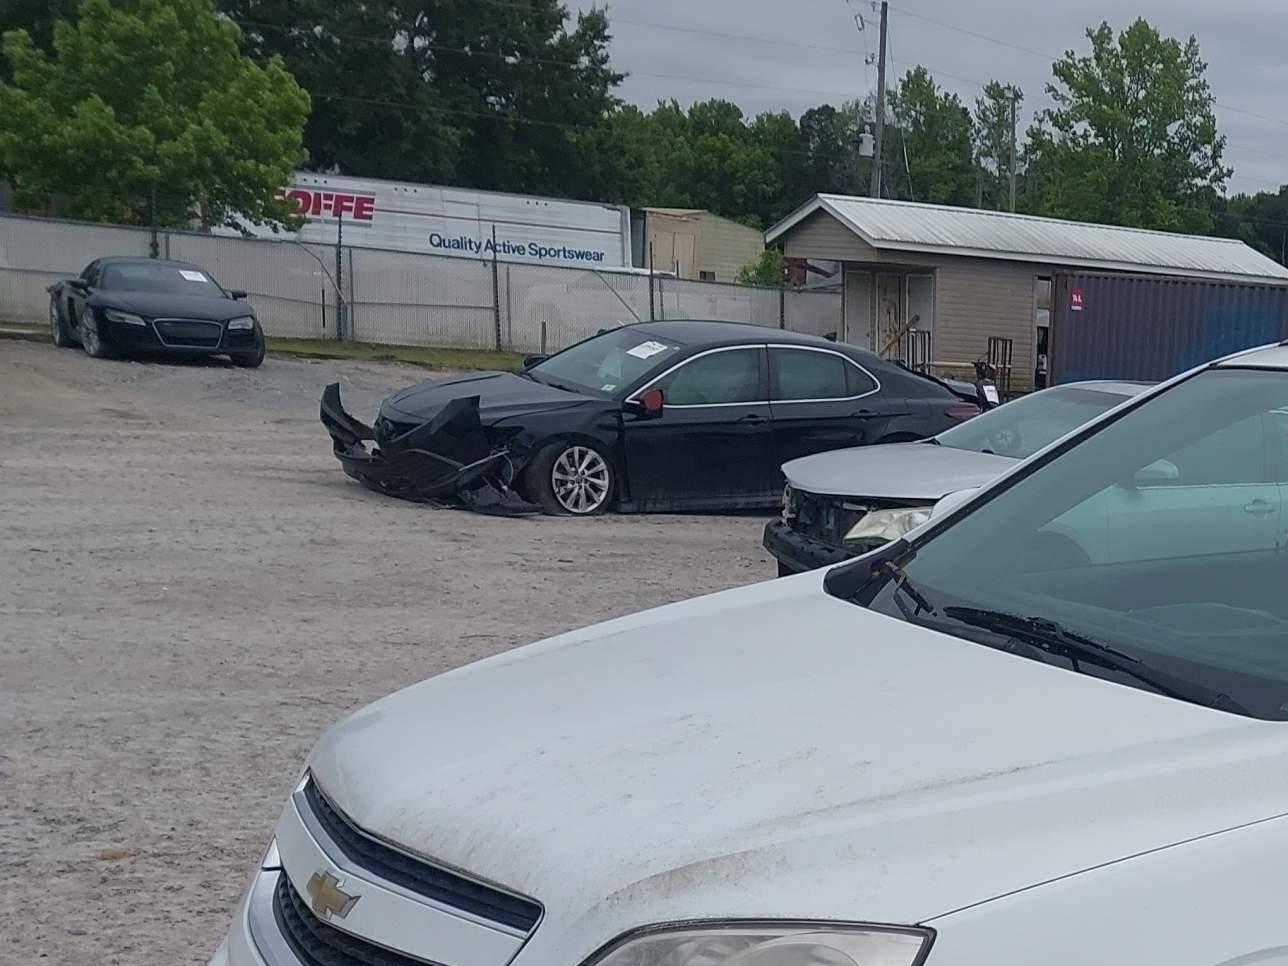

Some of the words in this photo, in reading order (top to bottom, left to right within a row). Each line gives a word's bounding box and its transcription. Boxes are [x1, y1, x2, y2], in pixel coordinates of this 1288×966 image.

[429, 233, 482, 255] Quality
[484, 238, 526, 256] Active
[528, 242, 605, 263] Sportswear
